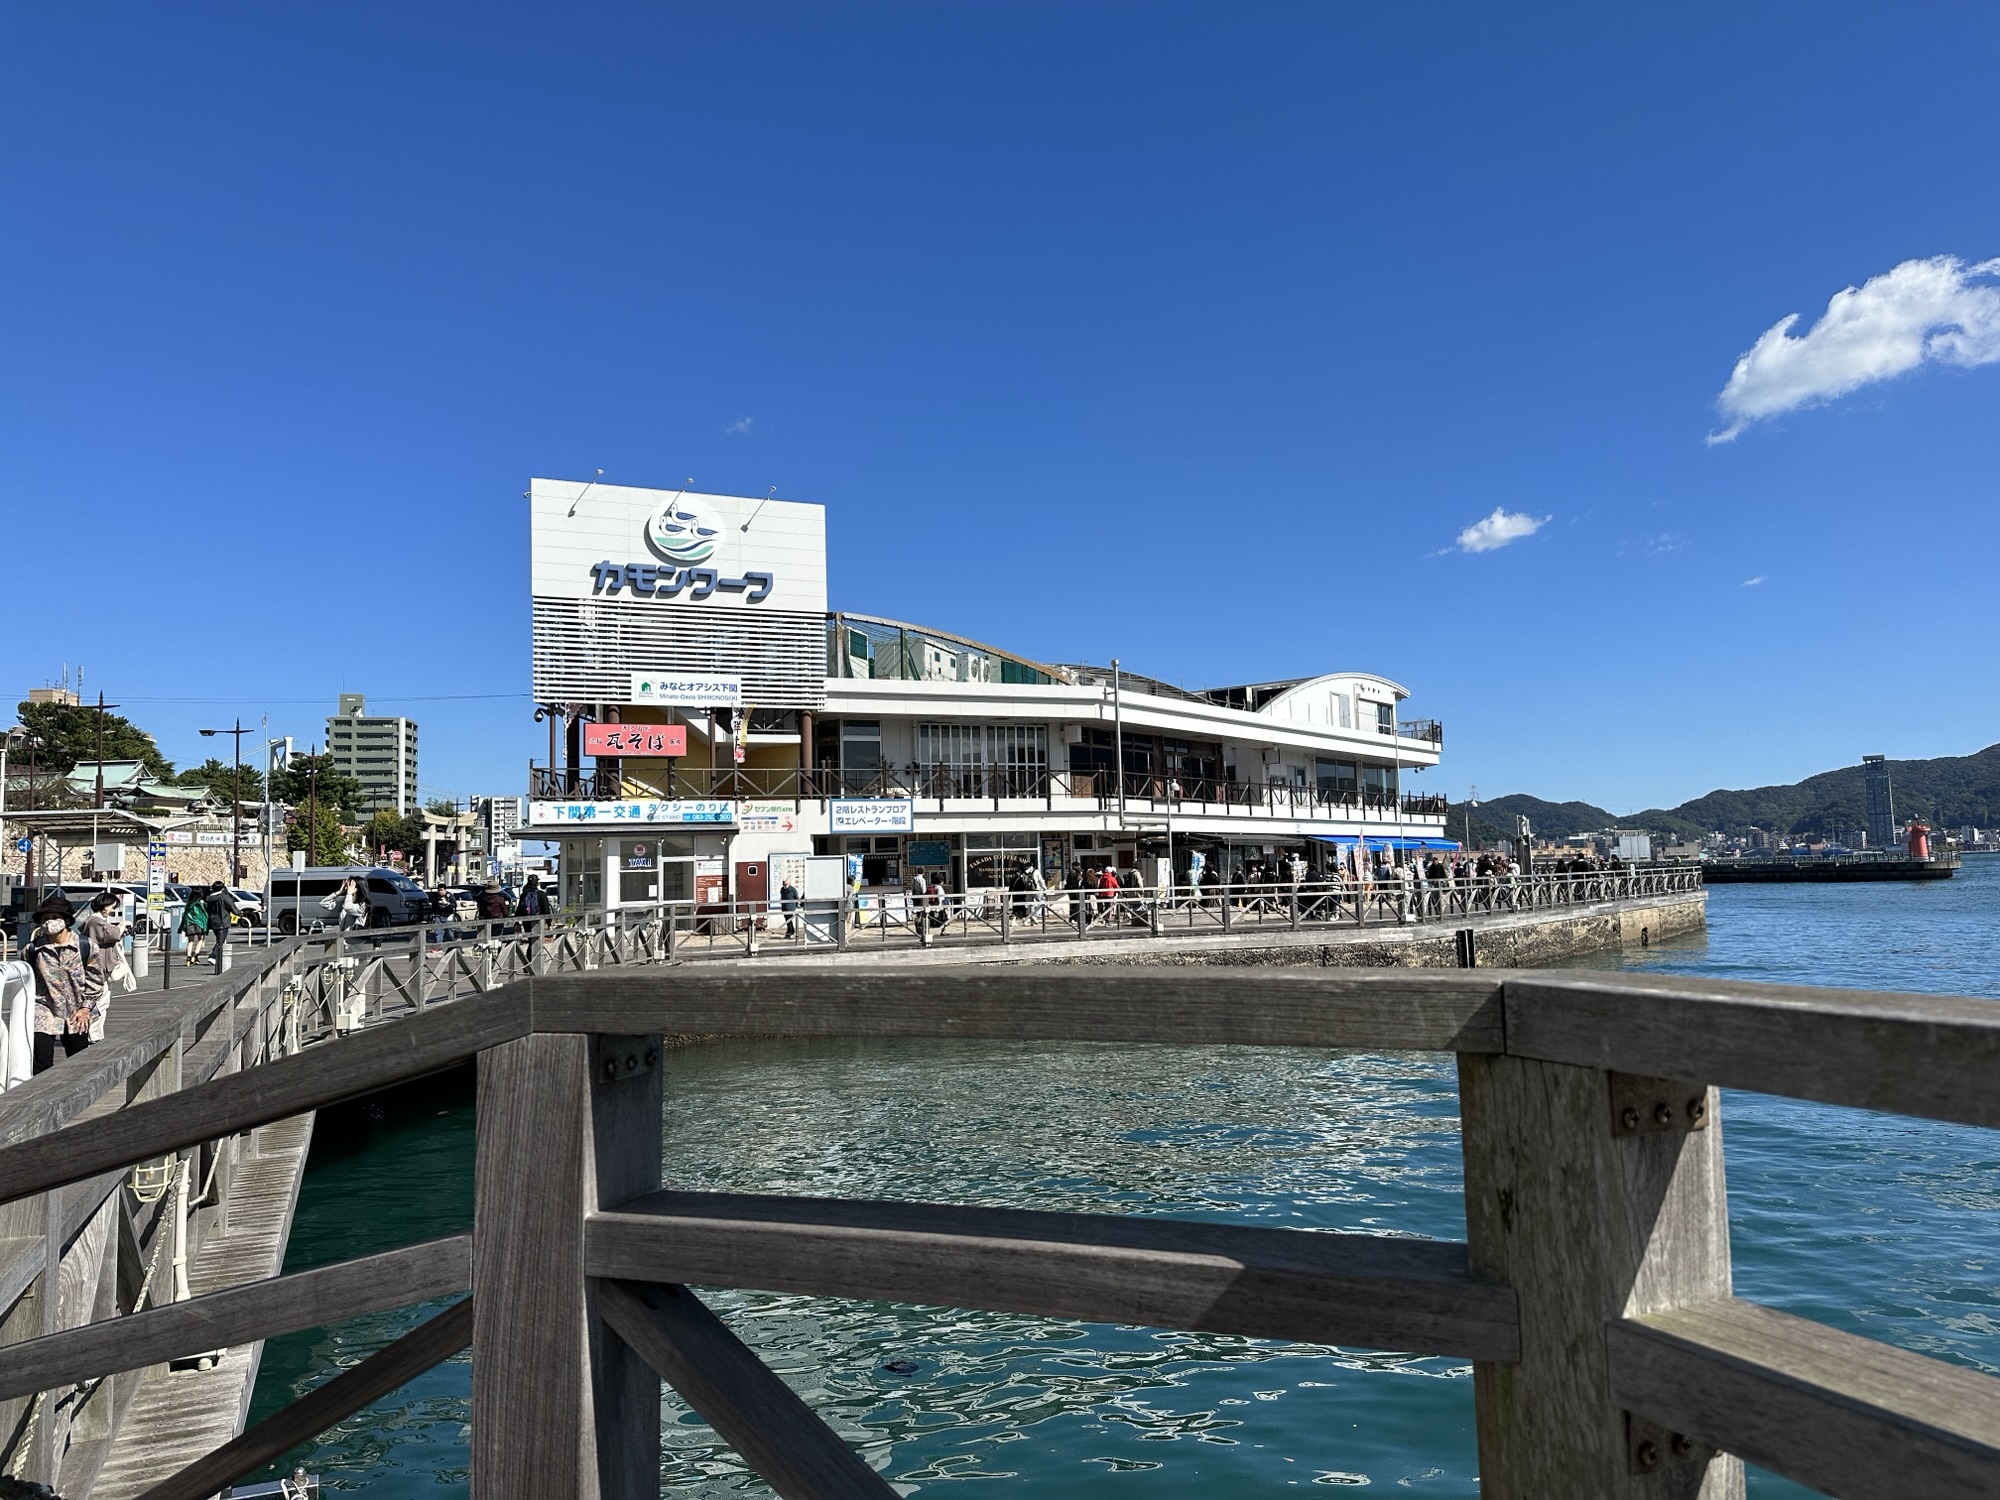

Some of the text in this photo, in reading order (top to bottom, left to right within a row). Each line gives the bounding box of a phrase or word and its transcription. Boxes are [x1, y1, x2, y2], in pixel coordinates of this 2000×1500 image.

[594, 560, 773, 598] カモンワーフ
[659, 681, 738, 693] みなとオアシス下関
[606, 733, 666, 751] 瓦そば
[552, 805, 641, 819] 下関第一交通
[836, 805, 907, 814] 2階レストランフロア
[845, 816, 907, 825] エレベーター・階段
[628, 858, 652, 867] TAXI
[969, 855, 992, 869] TAKADA
